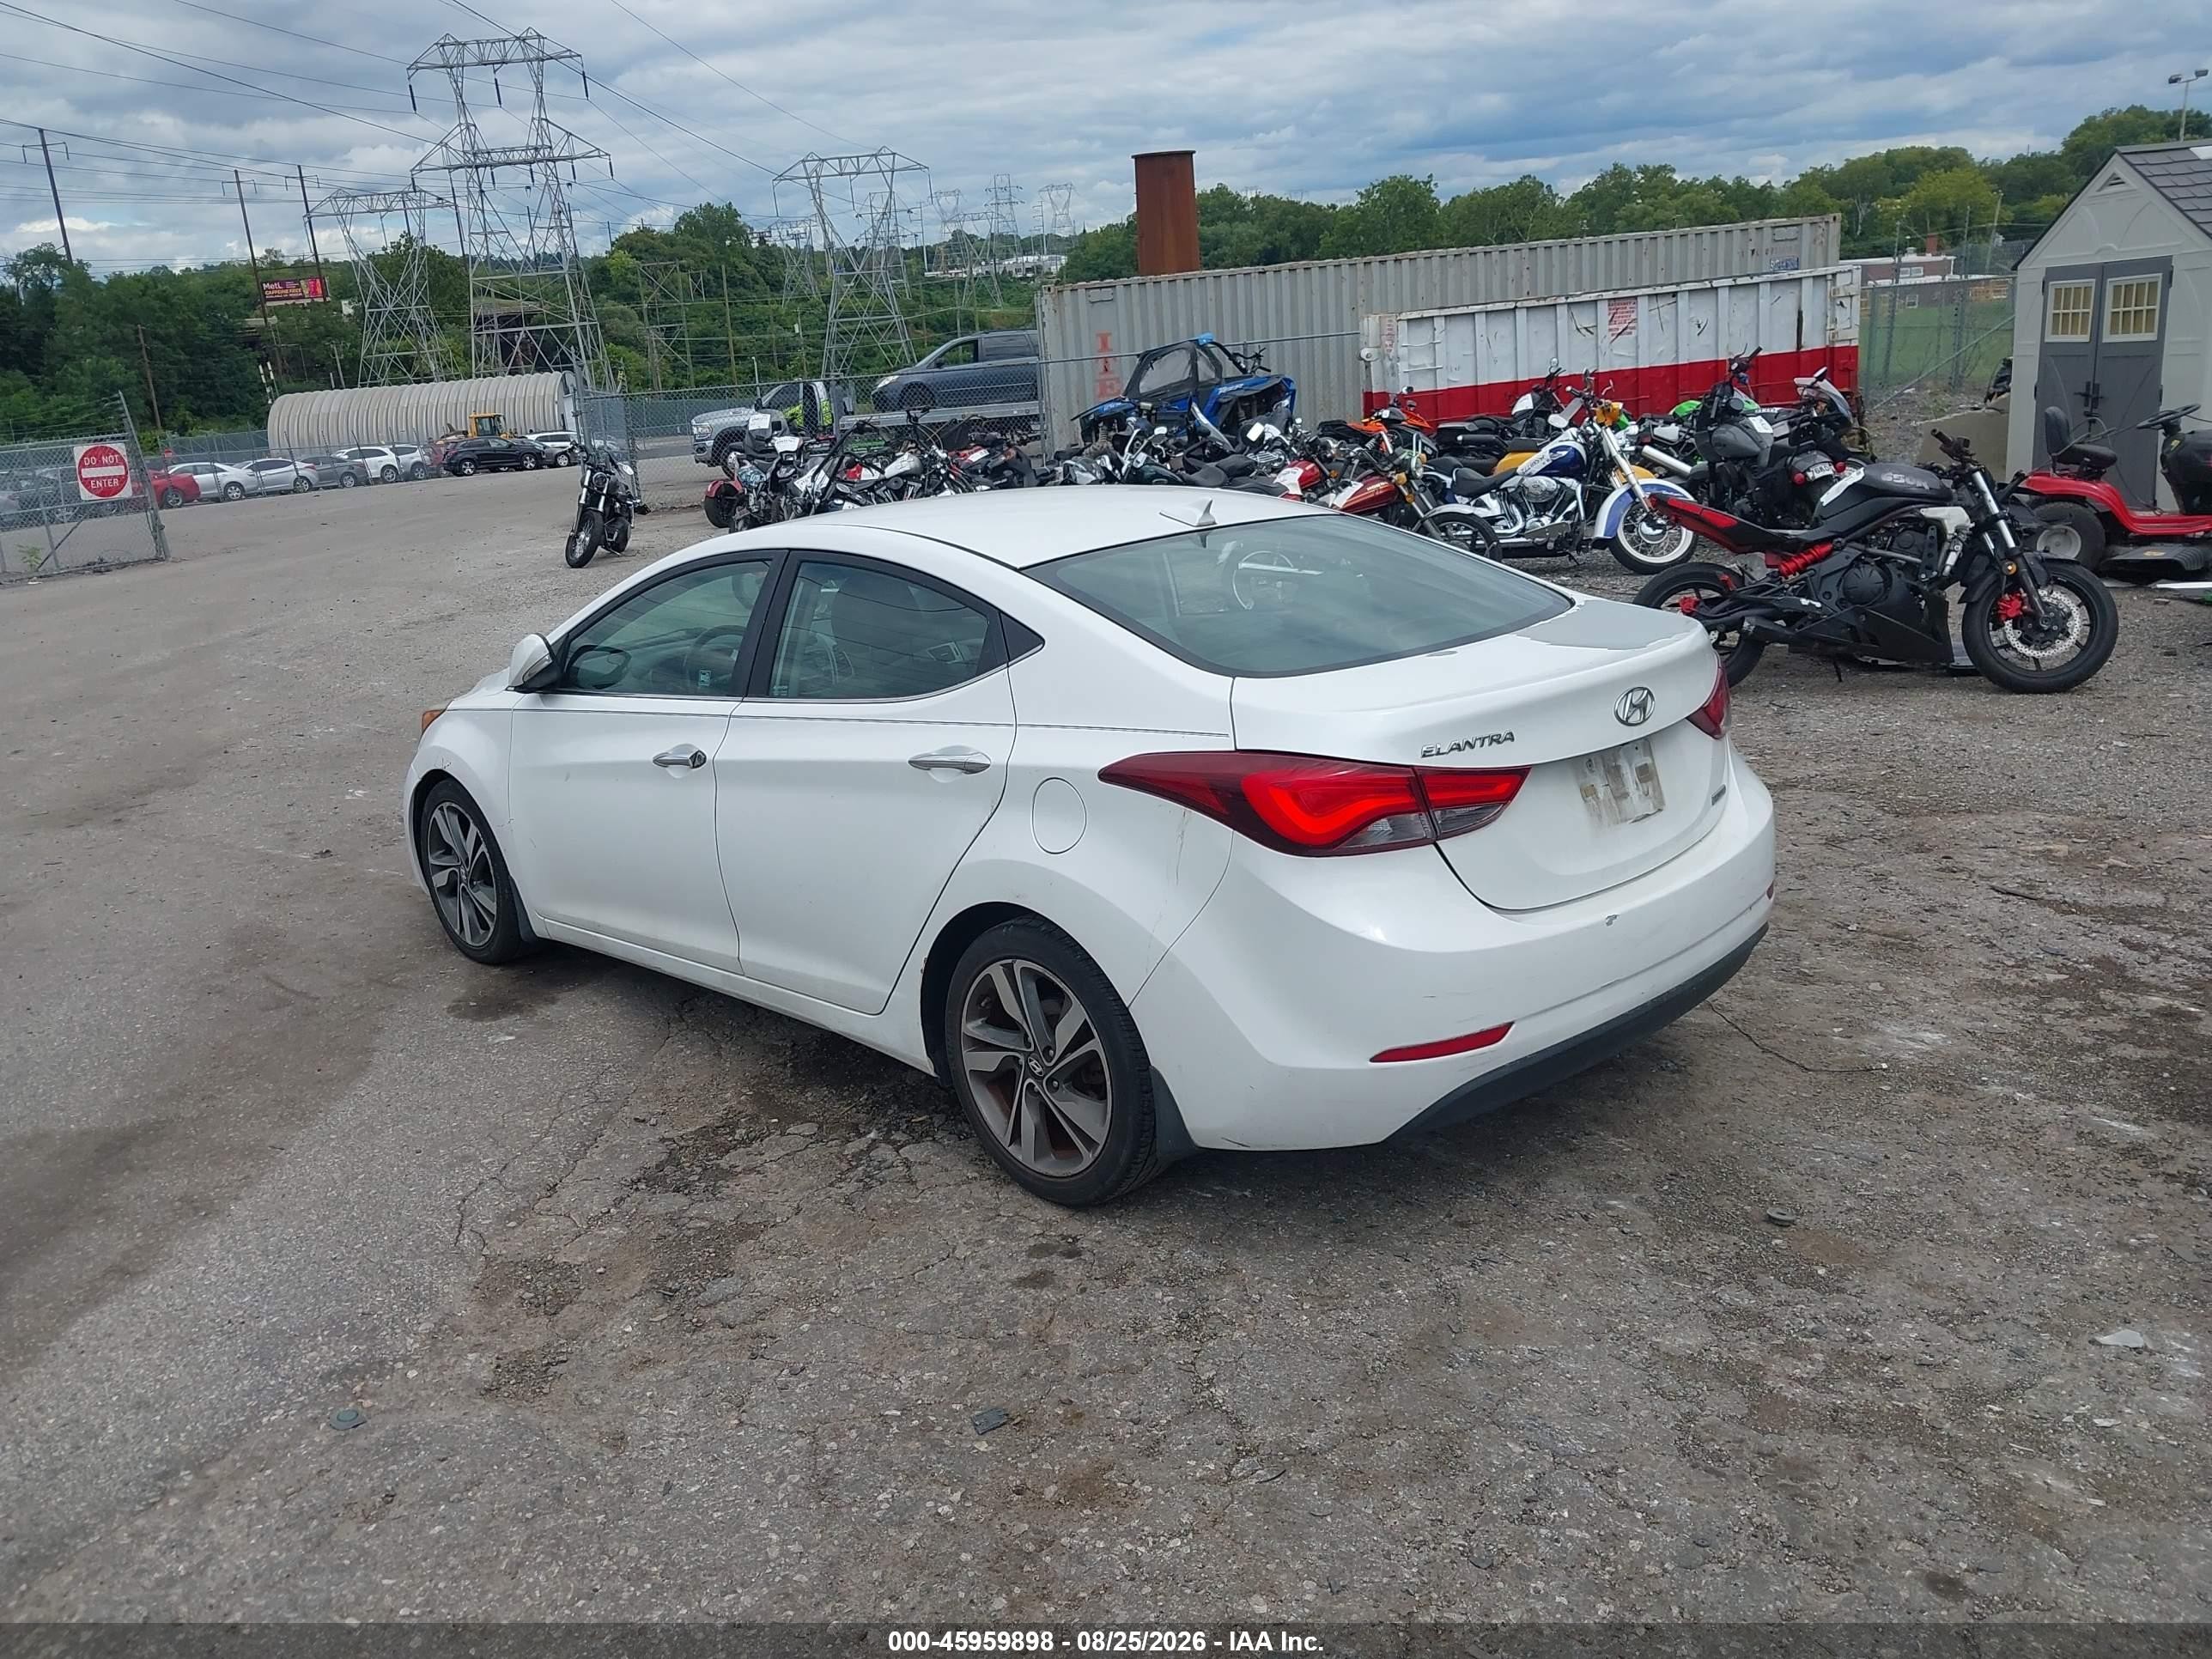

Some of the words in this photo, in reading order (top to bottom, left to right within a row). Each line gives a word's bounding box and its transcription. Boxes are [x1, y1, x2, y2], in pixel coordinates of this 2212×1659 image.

[83, 456, 97, 466] DO
[101, 454, 120, 465] NOT
[90, 478, 119, 489] ENTER
[1421, 729, 1515, 758] ELANTRA
